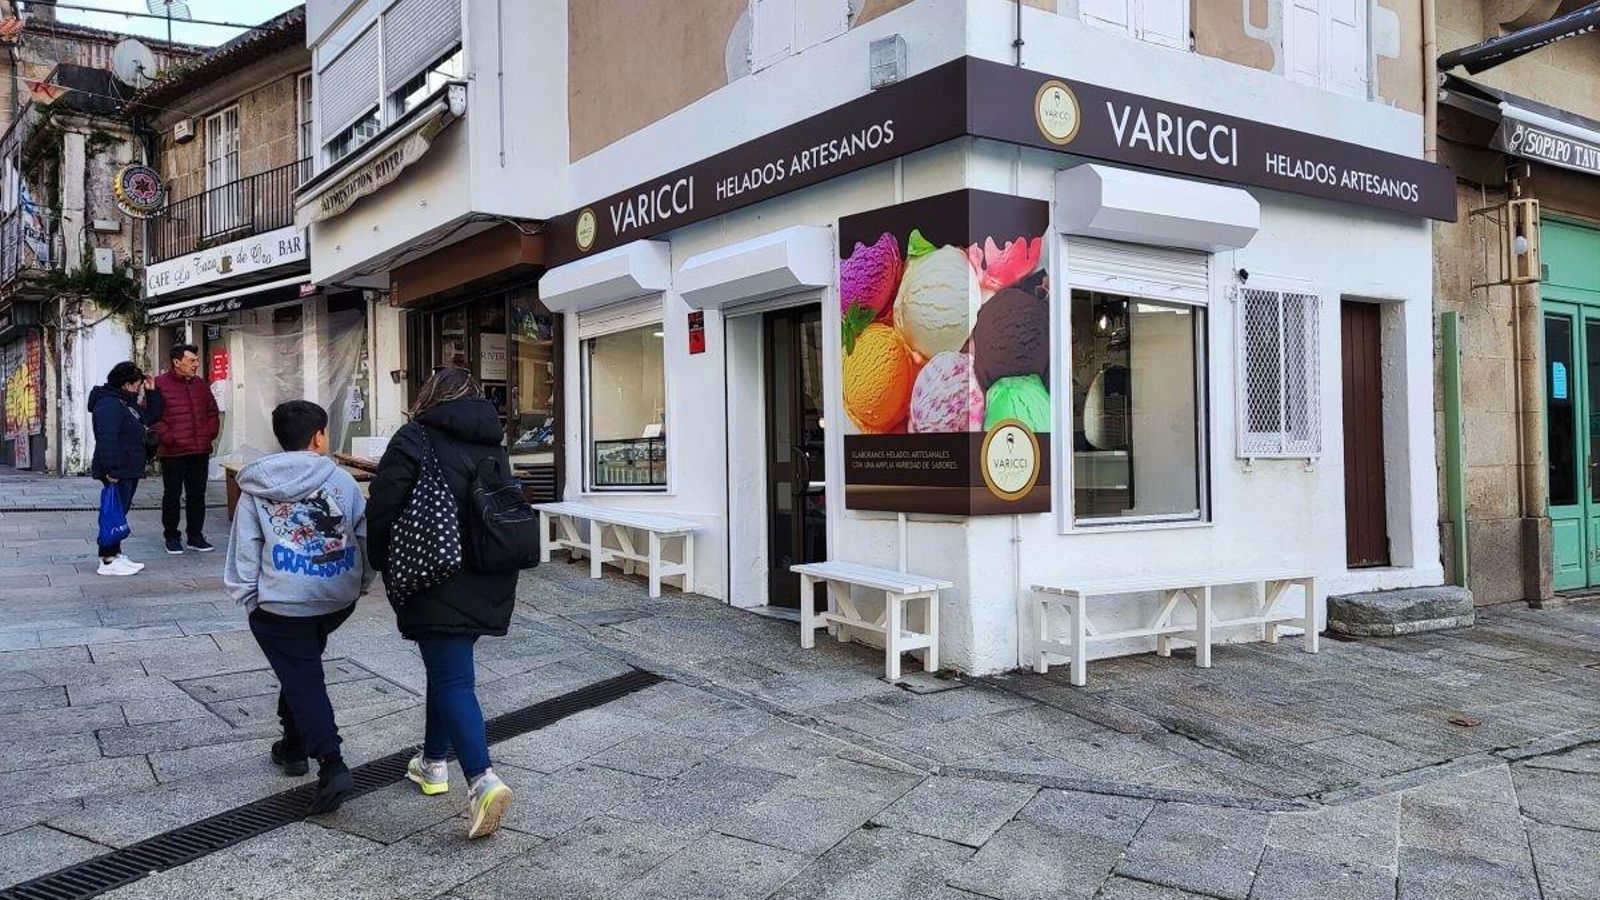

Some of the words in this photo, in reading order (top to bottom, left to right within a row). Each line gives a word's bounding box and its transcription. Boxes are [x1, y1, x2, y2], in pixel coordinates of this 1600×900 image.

[1106, 101, 1238, 167] VARICCI
[1265, 152, 1337, 185] HELADOS
[1340, 169, 1419, 203] ARTESANOS
[1525, 132, 1570, 162] SOPAPO
[609, 175, 694, 236] VARICCI
[716, 158, 785, 201] HELADOS
[789, 120, 895, 177] ARTESANOS
[236, 245, 248, 264] de
[278, 236, 302, 257] BAR
[993, 457, 1028, 469] VARICCI
